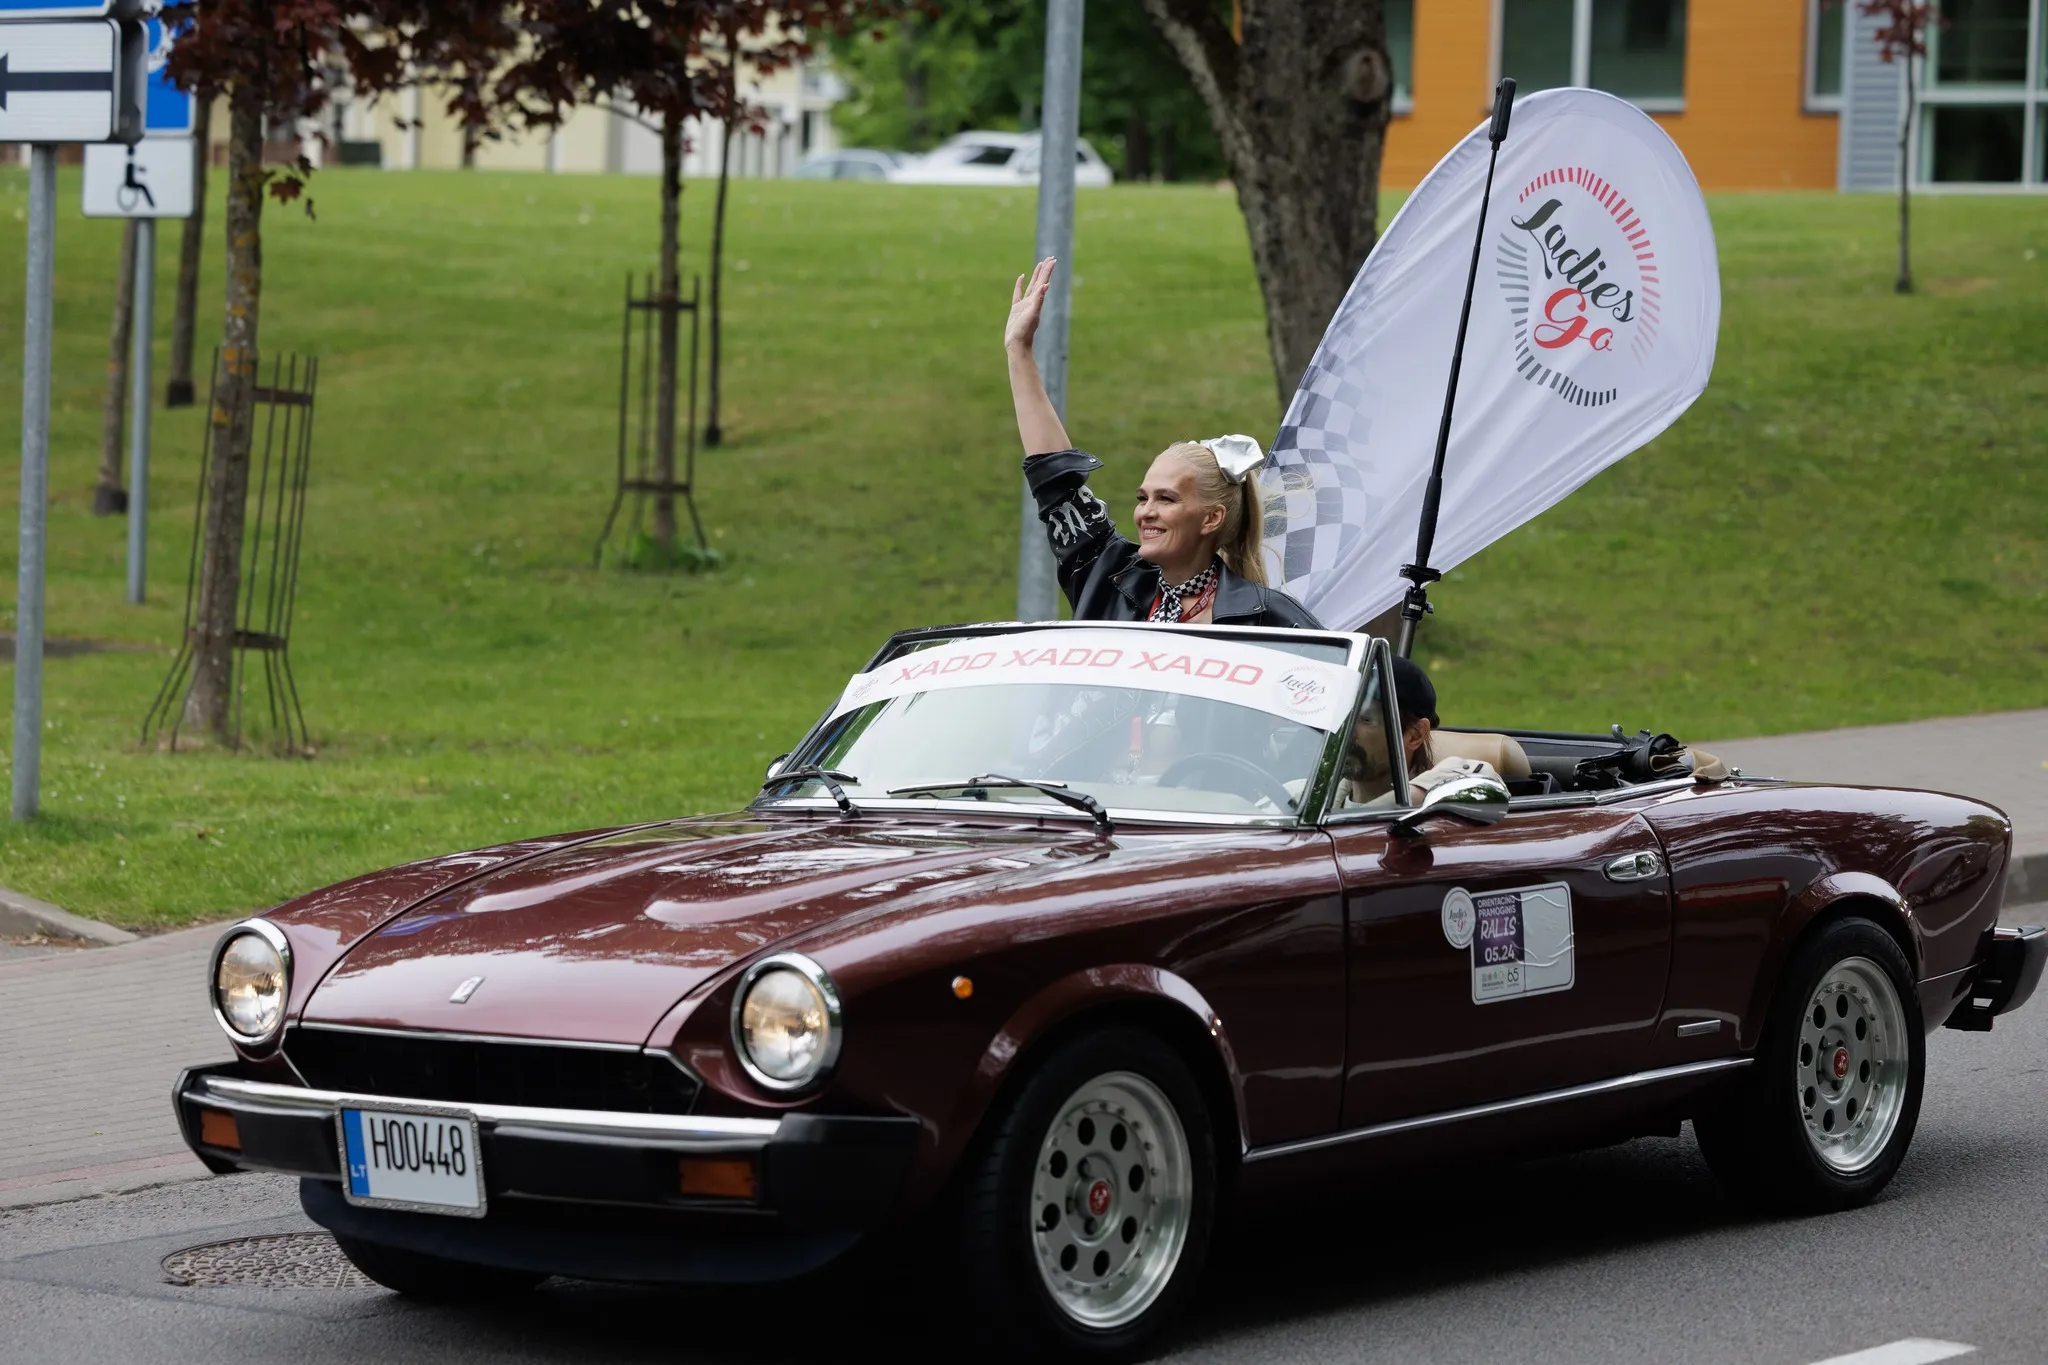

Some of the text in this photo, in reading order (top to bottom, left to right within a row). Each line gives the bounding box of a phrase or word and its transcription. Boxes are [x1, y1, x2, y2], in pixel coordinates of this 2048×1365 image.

[1511, 198, 1634, 322] Ladies
[1533, 287, 1613, 351] Go
[890, 648, 1264, 685] XADO XADO XADO
[1277, 674, 1326, 695] Ladies
[1478, 904, 1517, 918] PRAMOGINIS
[1480, 916, 1517, 940] RALIS
[1484, 944, 1515, 963] 05.24
[370, 1117, 466, 1176] H00448
[351, 1164, 366, 1178] LT
